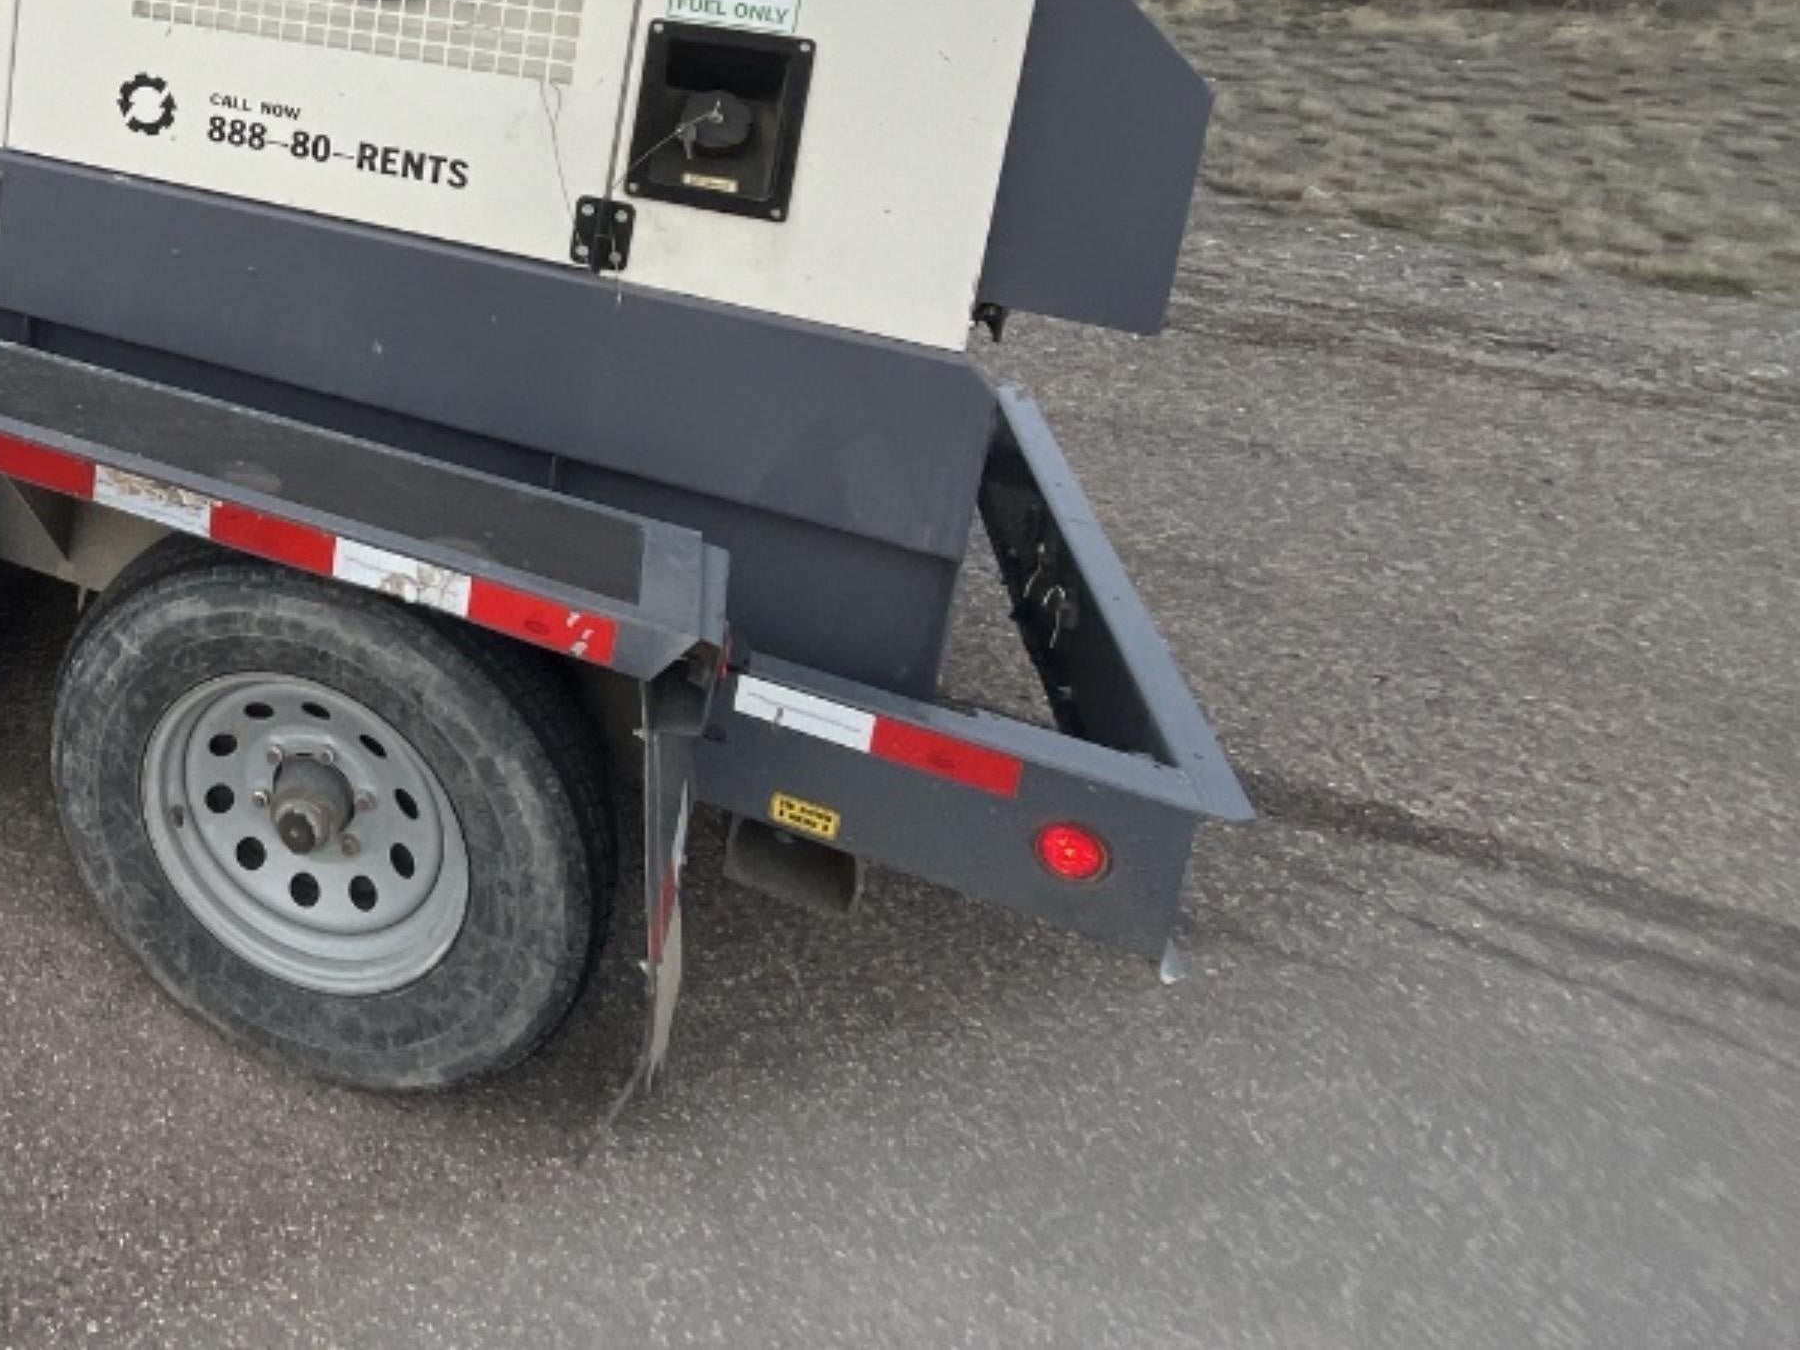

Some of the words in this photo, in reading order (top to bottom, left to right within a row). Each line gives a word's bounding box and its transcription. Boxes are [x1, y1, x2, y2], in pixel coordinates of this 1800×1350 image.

[734, 2, 789, 24] ONLY
[209, 92, 252, 112] CALL
[260, 101, 301, 120] NOW
